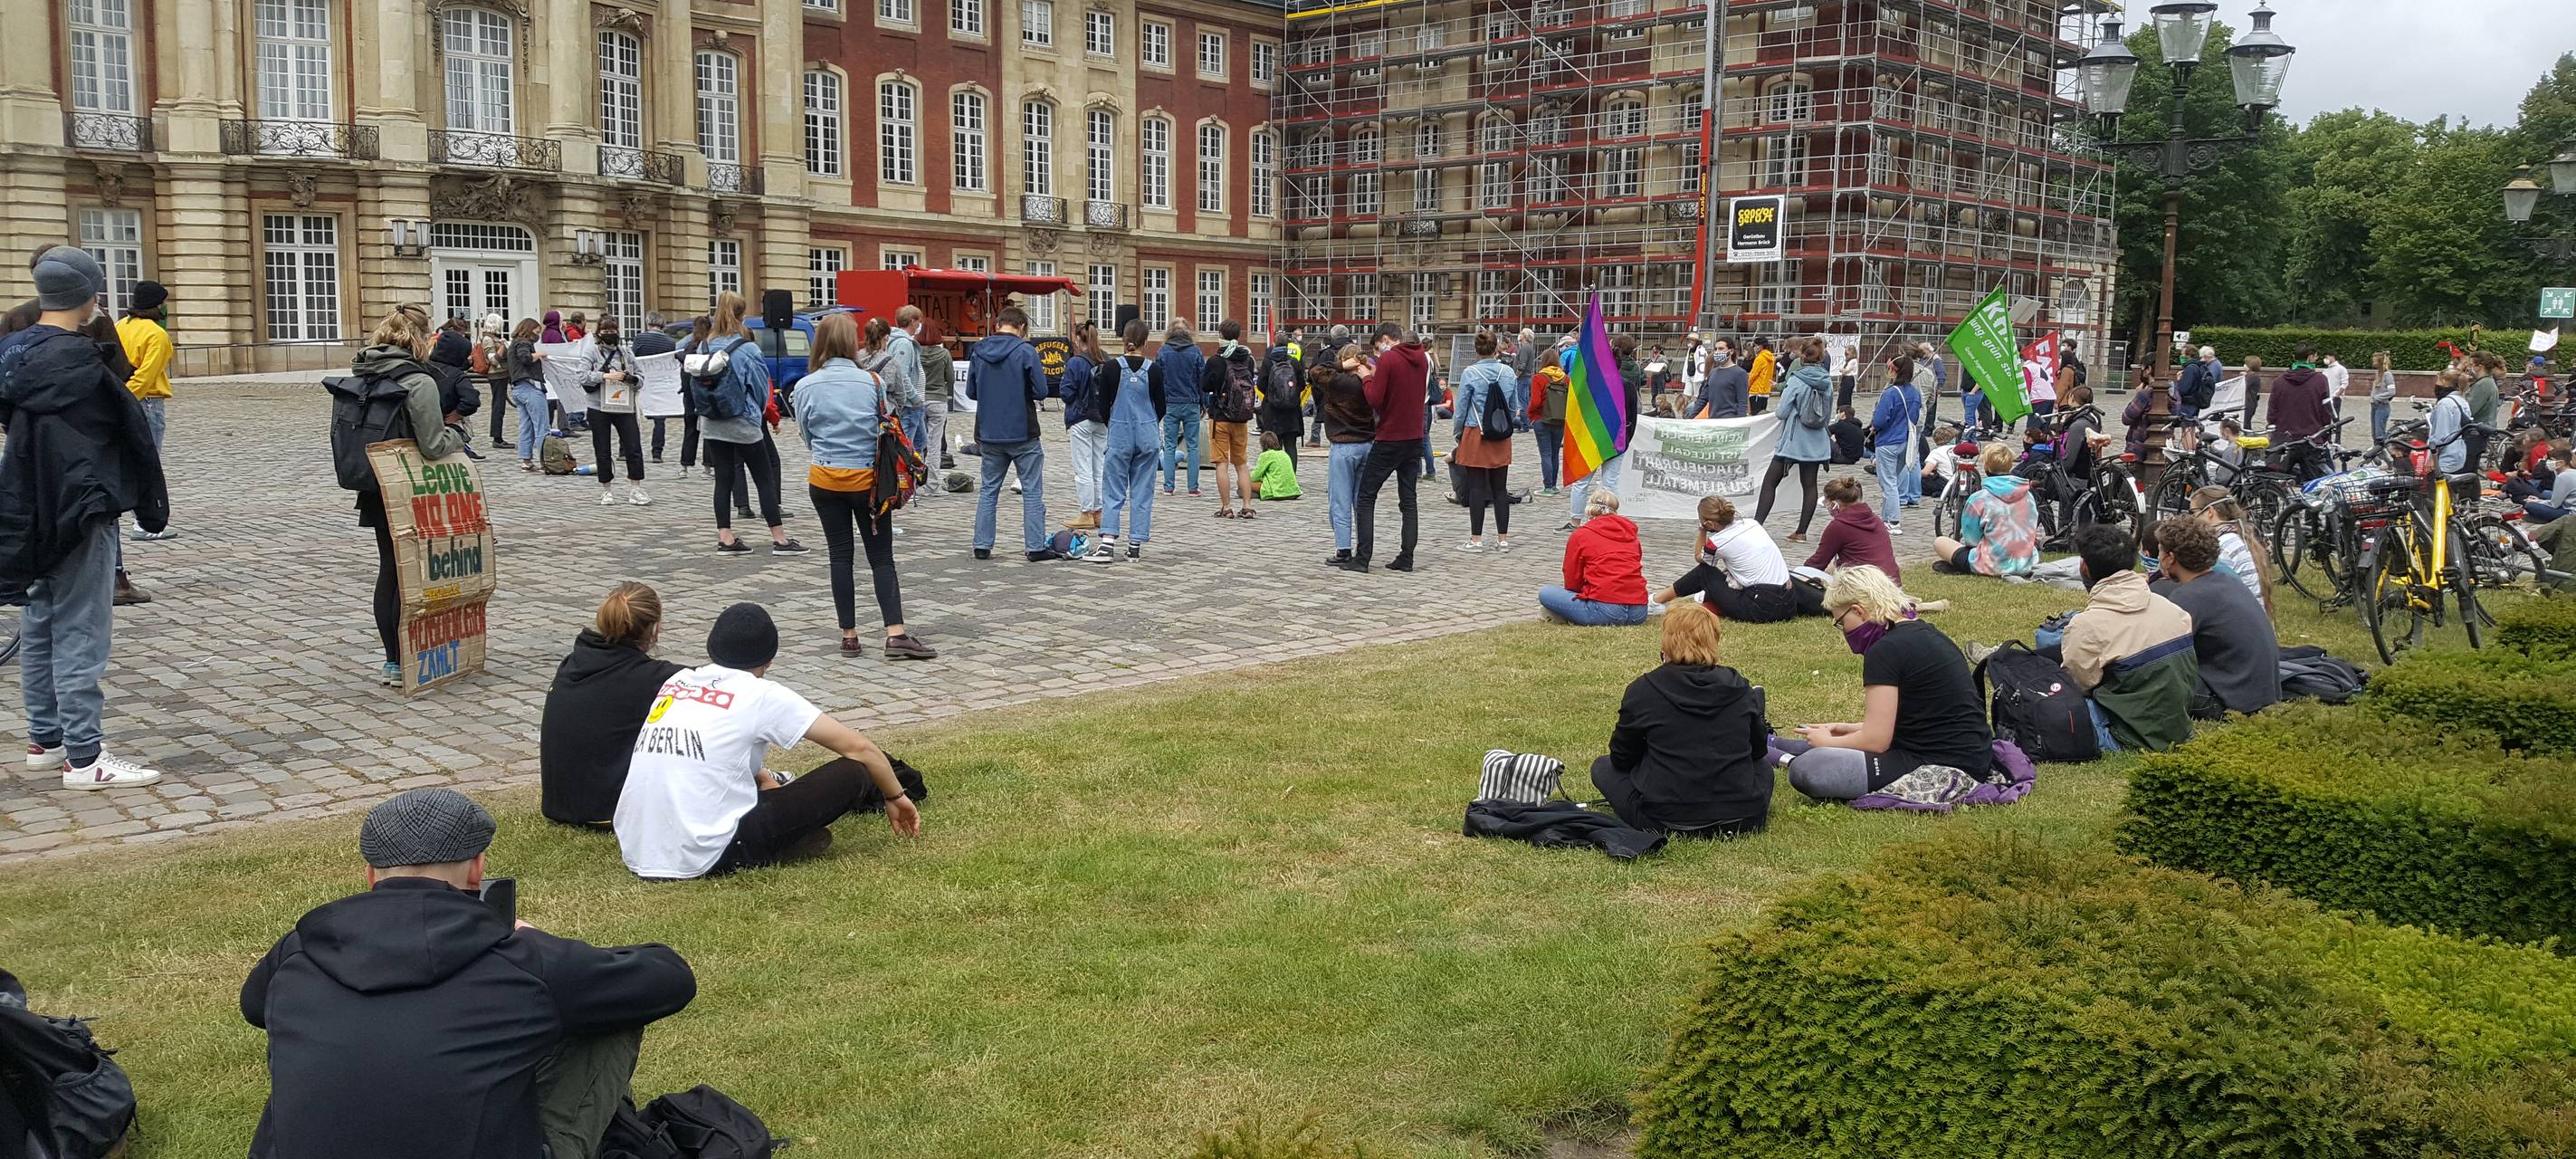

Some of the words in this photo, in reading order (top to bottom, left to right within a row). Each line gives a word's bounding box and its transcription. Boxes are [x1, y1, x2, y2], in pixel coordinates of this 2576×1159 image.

[1035, 340, 1069, 354] REFUGEES
[400, 454, 474, 495] Leave
[412, 495, 439, 540] NO
[436, 492, 486, 536] ONE
[427, 533, 482, 580] behind
[647, 727, 706, 762] BERLIN
